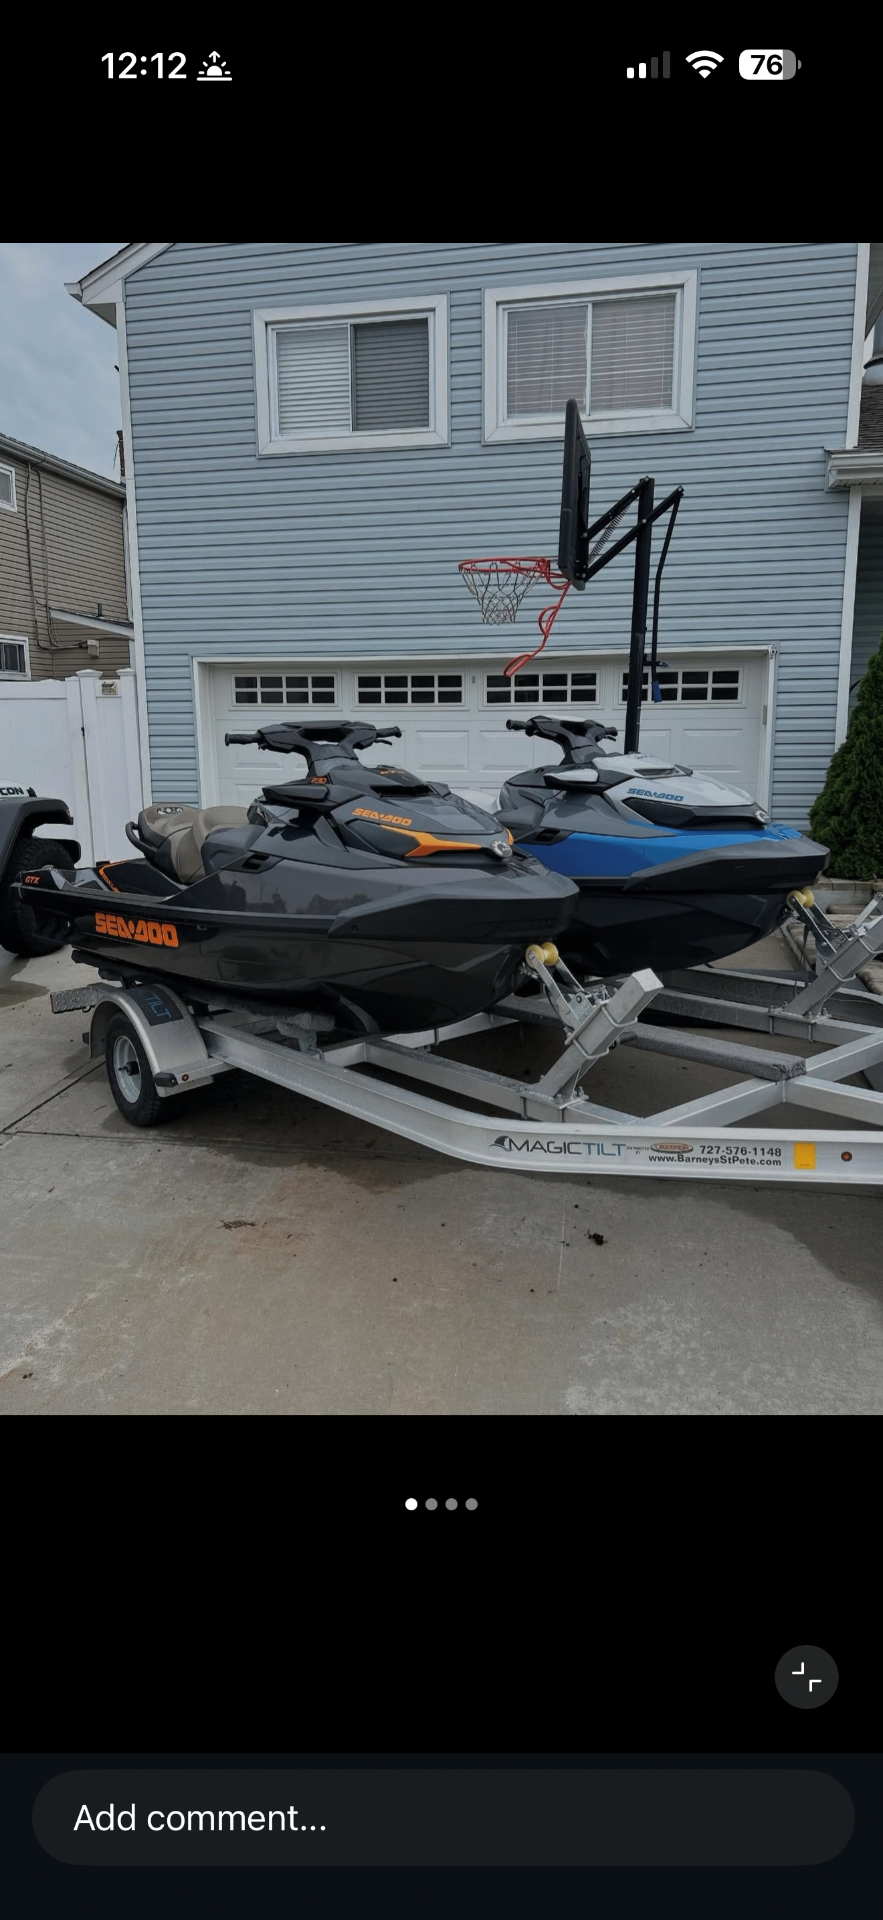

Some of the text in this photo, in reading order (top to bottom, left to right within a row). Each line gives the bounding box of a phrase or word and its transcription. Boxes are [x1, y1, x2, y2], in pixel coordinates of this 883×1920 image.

[24, 875, 40, 884] GTX
[699, 1145, 782, 1157] 727-576-1148
[648, 1154, 782, 1166] www.BarneysStPete.com
